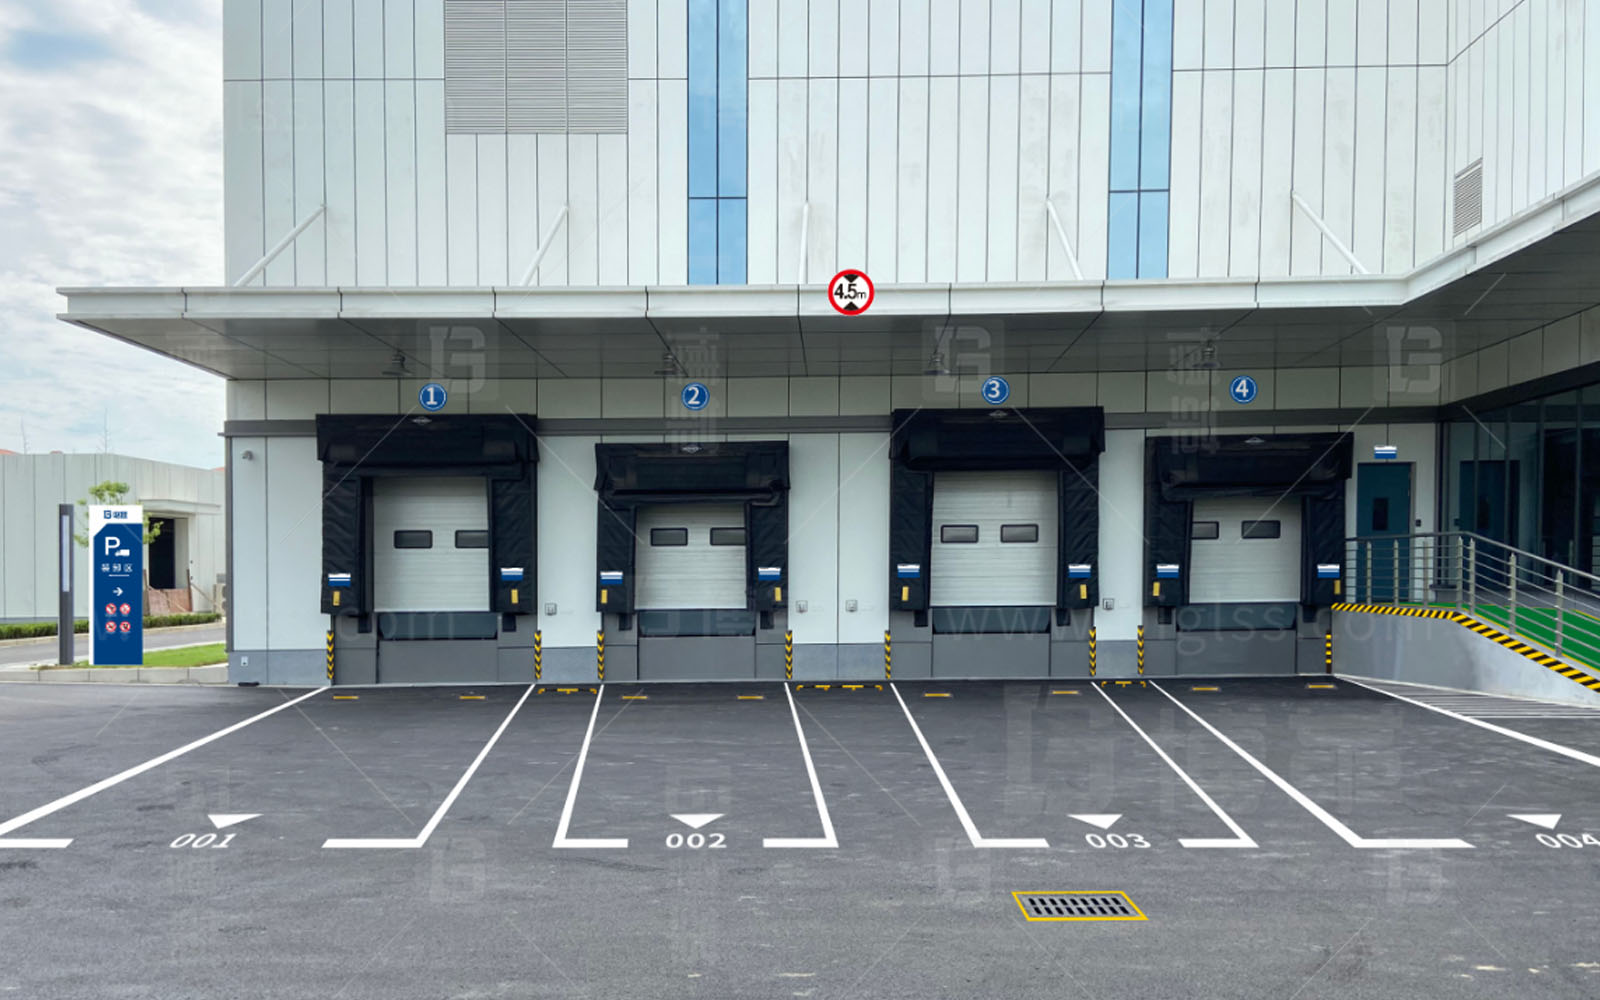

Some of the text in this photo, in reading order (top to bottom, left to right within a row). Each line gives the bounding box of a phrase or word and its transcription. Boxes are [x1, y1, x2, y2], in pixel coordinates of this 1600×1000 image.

[834, 283, 867, 300] 4.5m
[426, 387, 438, 405] 1
[687, 386, 701, 405] 2
[988, 380, 1000, 398] 3
[1235, 379, 1249, 397] 4
[104, 536, 121, 556] P
[169, 833, 237, 849] 001
[665, 833, 728, 849] 002
[1085, 833, 1152, 849] 003
[1535, 833, 1600, 848] 004
